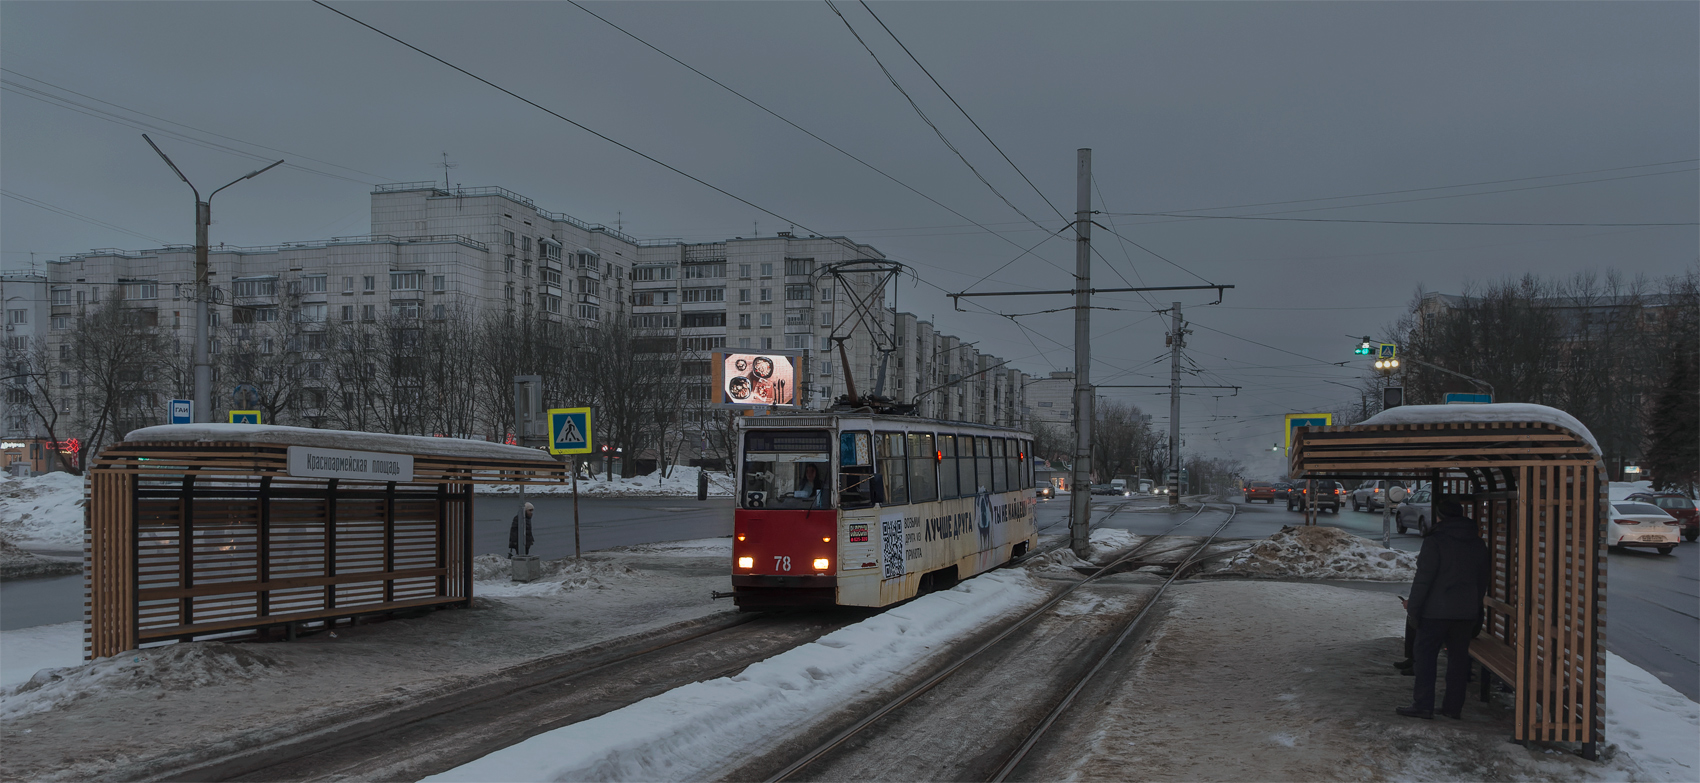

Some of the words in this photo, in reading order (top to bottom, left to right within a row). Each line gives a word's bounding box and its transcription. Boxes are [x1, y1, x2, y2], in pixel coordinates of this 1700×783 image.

[307, 453, 368, 473] Красноармейская
[372, 459, 400, 476] площадь
[748, 491, 764, 507] 8
[904, 516, 921, 529] ВОЗЬМИ
[925, 515, 952, 542] ЛУЧШЕ
[953, 512, 973, 541] ДРУГА
[906, 547, 923, 561] ПРИЮТА
[774, 555, 791, 571] 78
